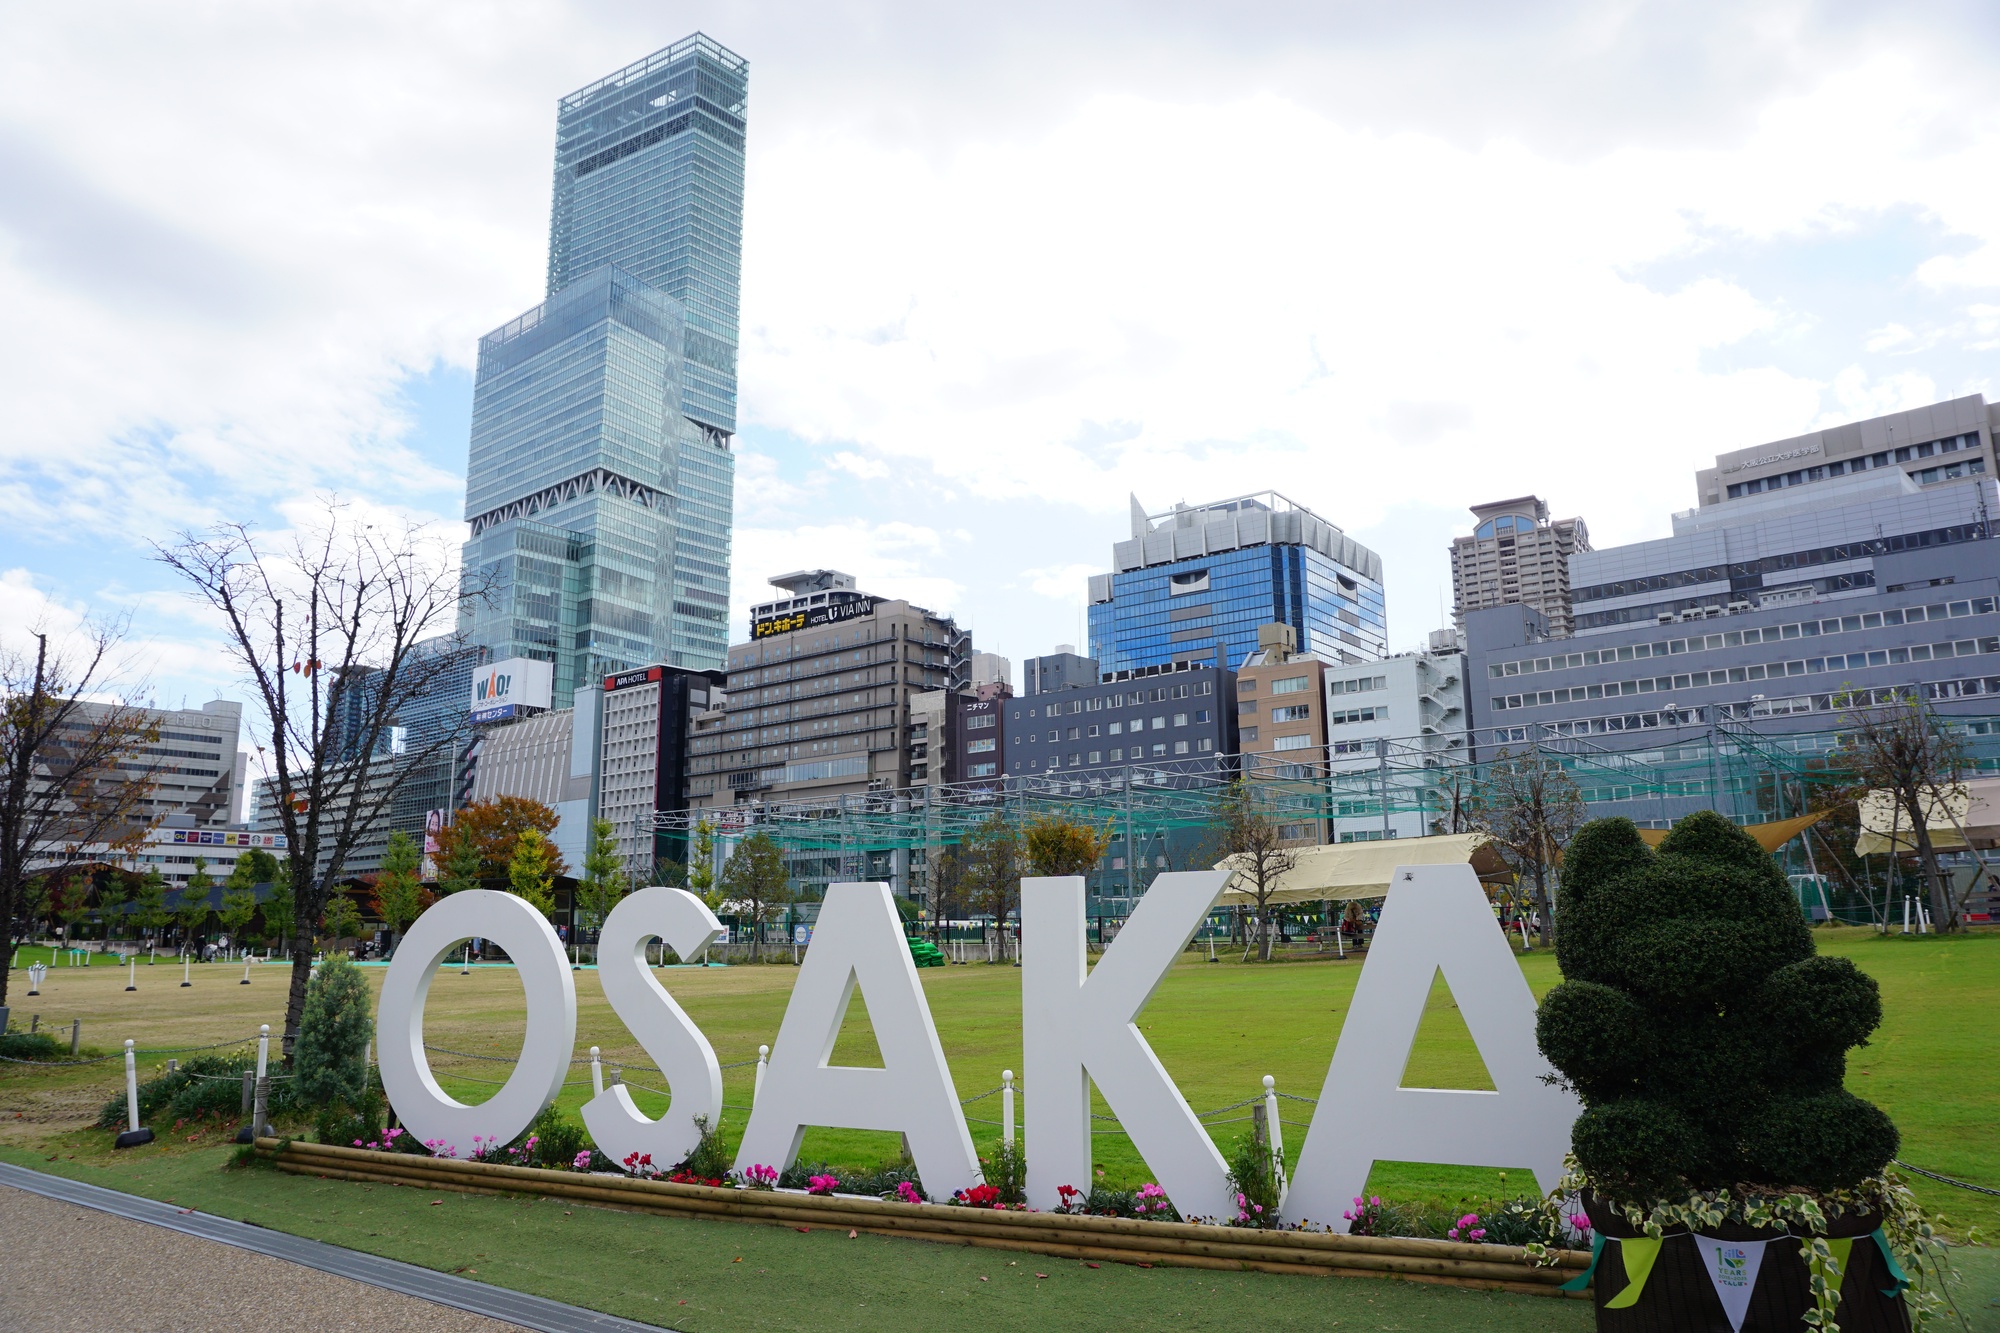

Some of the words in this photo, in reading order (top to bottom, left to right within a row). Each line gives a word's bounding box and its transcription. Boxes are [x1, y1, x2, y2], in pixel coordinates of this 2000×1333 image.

[1741, 444, 1820, 470] 大阪公立大学医学部
[810, 613, 828, 624] HOTEL
[839, 604, 854, 617] VIA
[855, 599, 871, 614] INN
[477, 667, 511, 700] WAO!
[616, 676, 628, 686] APA
[628, 672, 647, 684] HOTEL
[967, 702, 990, 711] ニチマン
[176, 714, 212, 728] MIO
[375, 863, 1592, 1243] OSAKA
[1718, 1267, 1747, 1276] YEARS
